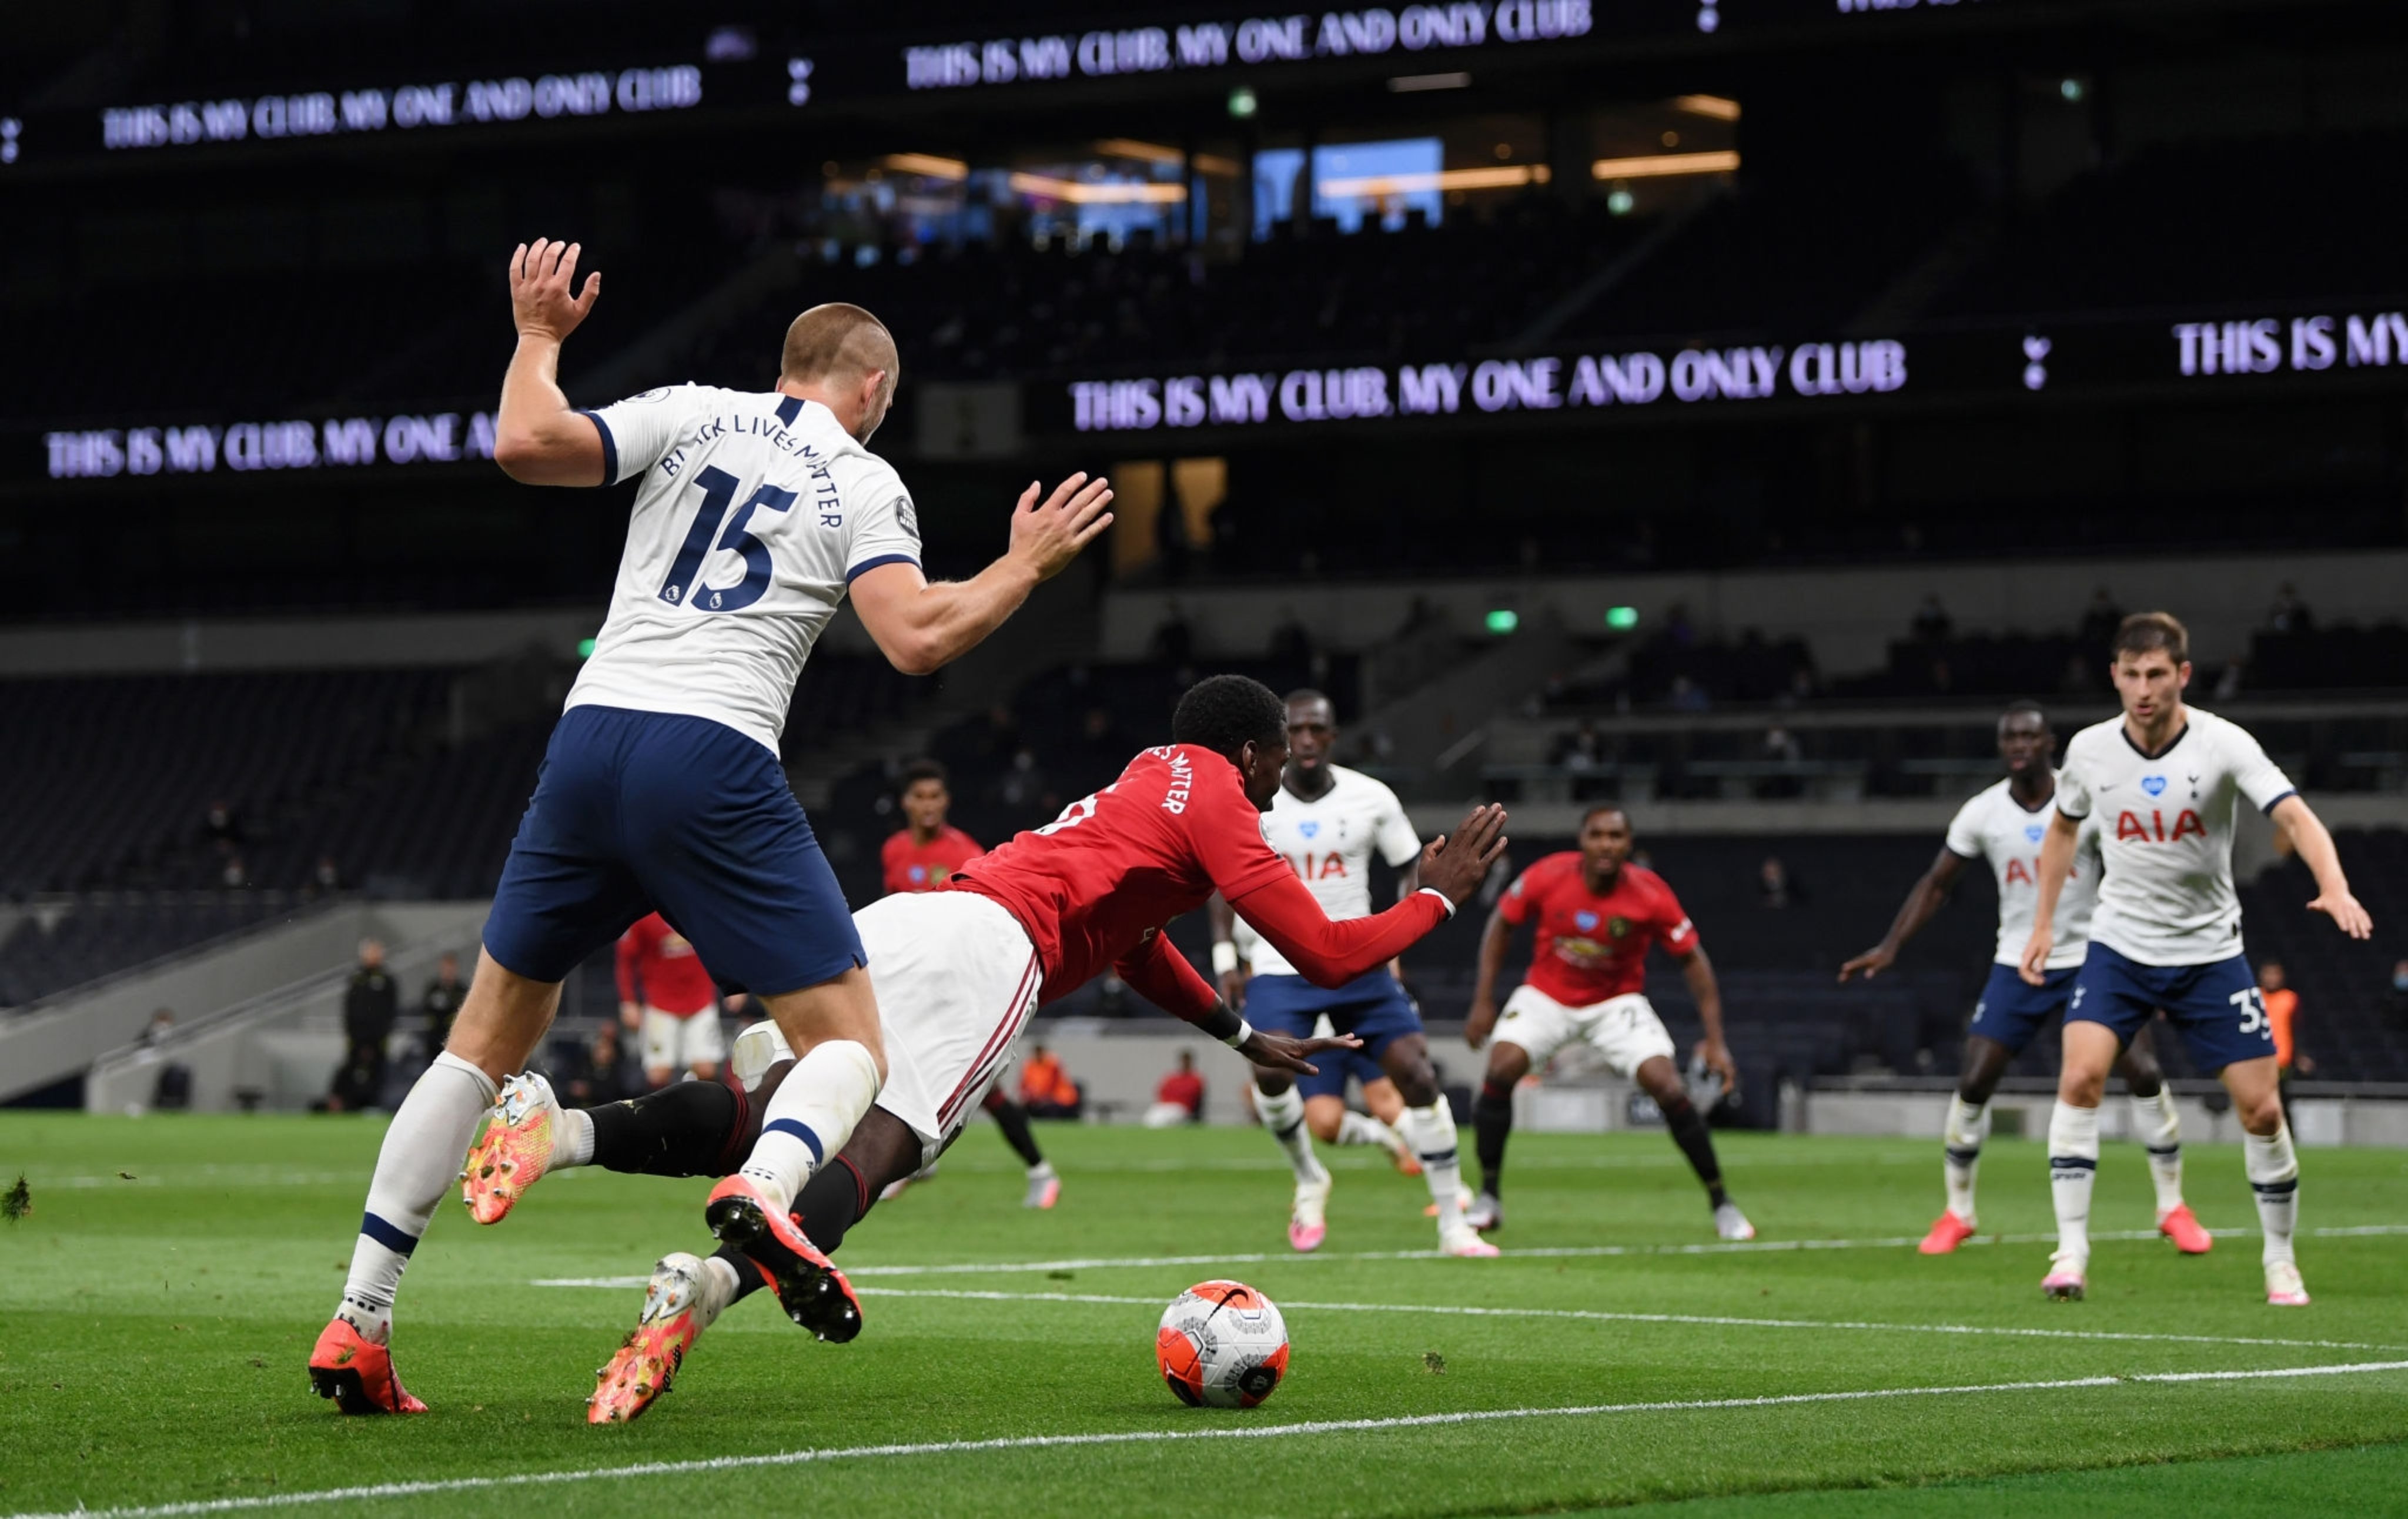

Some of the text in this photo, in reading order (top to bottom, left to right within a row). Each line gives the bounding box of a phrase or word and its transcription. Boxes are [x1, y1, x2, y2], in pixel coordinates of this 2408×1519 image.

[1019, 34, 1077, 79] MY
[1176, 21, 1233, 69] MY
[1236, 15, 1312, 63] ONE
[1315, 8, 1397, 57] AND
[1399, 3, 1493, 50] ONLY
[1495, 0, 1592, 42] CLUB
[461, 77, 533, 123] AND
[2172, 319, 2281, 375] THIS
[2290, 316, 2336, 371] IS
[1067, 378, 1161, 430] THIS
[1164, 376, 1205, 428] IS
[1209, 372, 1276, 424] MY
[1399, 362, 1469, 414] MY
[1471, 357, 1563, 412] ONE
[1568, 352, 1665, 408] AND
[1670, 345, 1784, 402] ONLY
[1790, 339, 1907, 396] CLUB
[165, 424, 223, 472] MY
[324, 416, 382, 465] MY
[384, 413, 462, 463] ONE
[661, 416, 727, 477] BLCK
[734, 414, 798, 451] LIVES
[658, 464, 798, 612] 15
[1161, 752, 1192, 814] MATTER
[2117, 809, 2206, 842] AIA
[2006, 856, 2078, 885] AI
